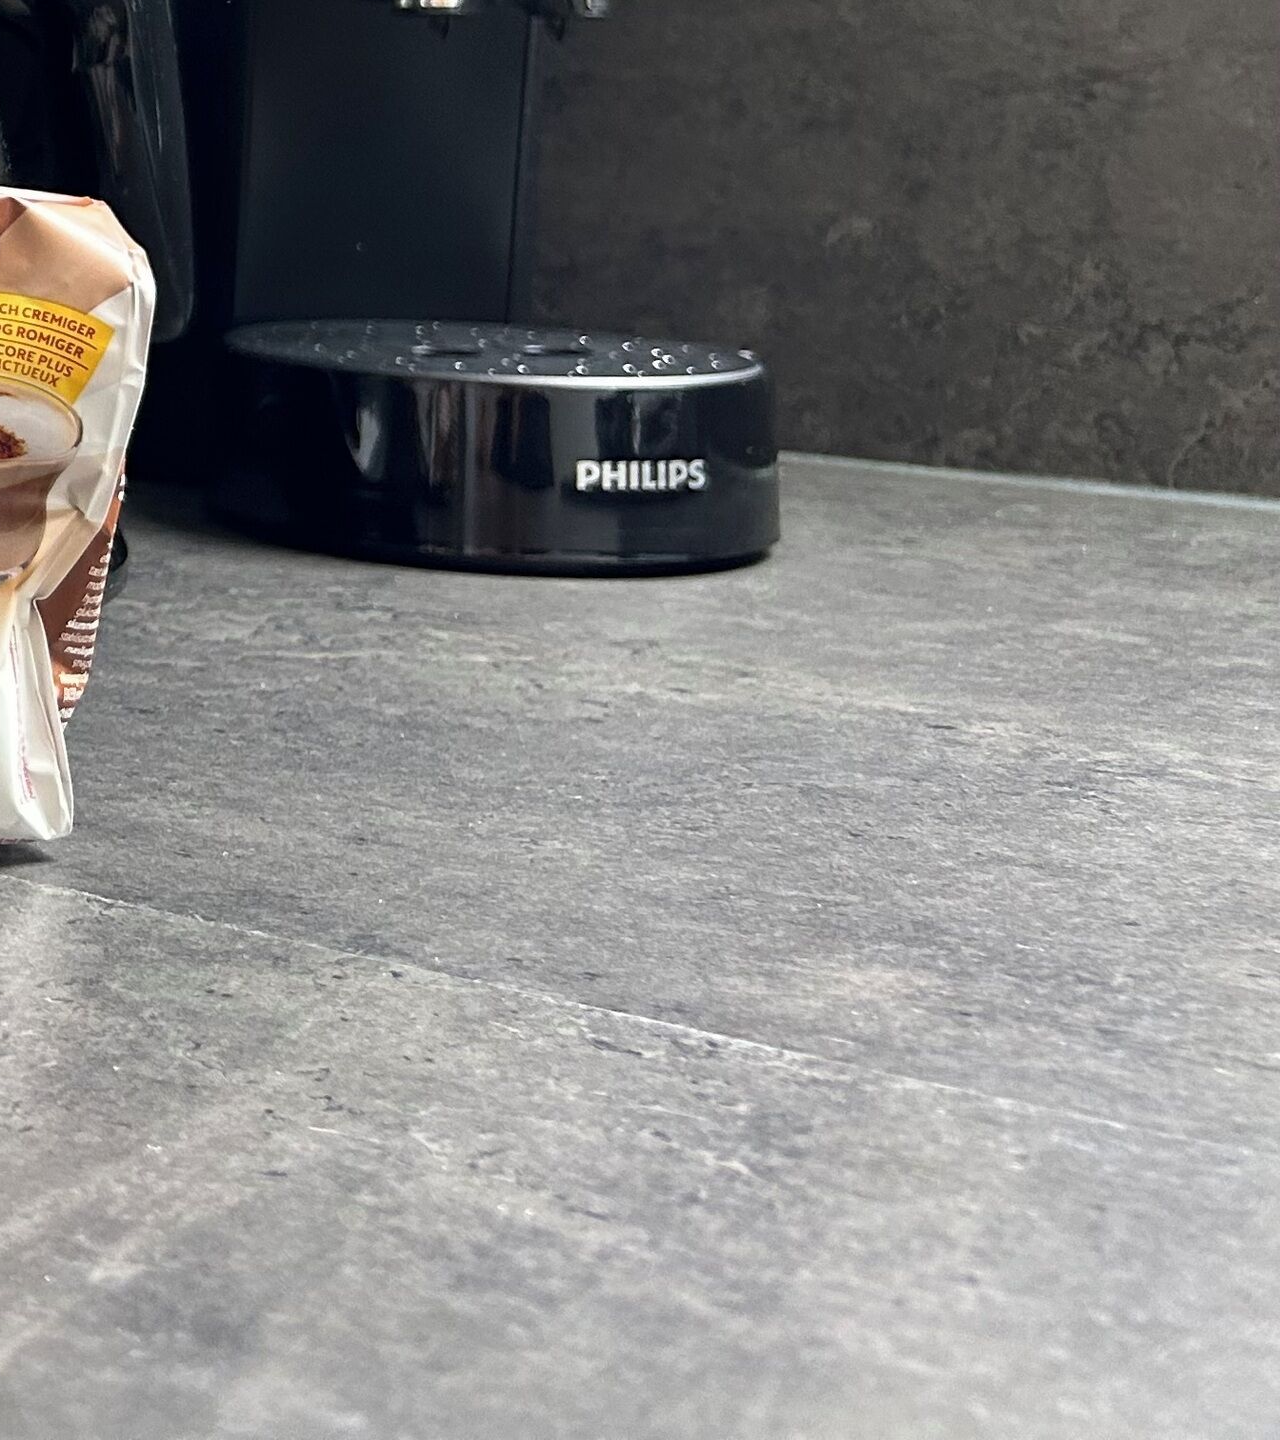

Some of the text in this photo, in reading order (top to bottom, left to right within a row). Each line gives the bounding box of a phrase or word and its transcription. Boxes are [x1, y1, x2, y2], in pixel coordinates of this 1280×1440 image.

[22, 306, 97, 340] CREMIGER
[16, 326, 85, 360] ROMIGER
[39, 354, 74, 378] PLUS
[576, 459, 707, 492] PHILIPS
